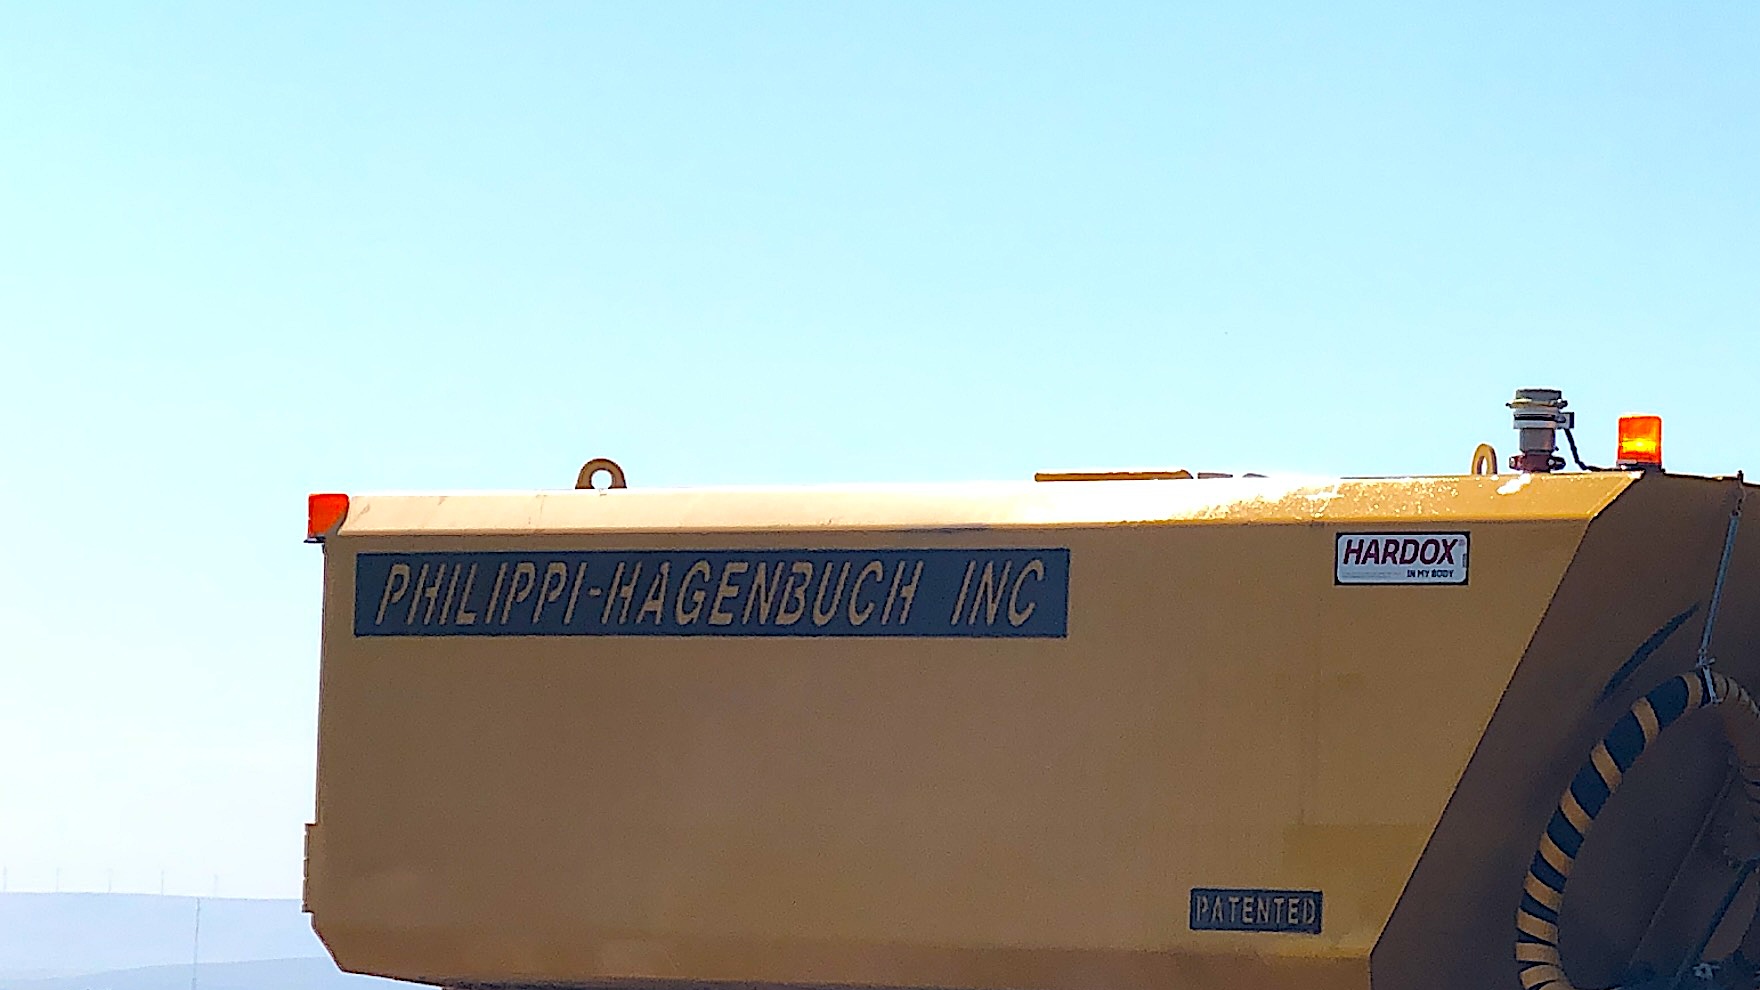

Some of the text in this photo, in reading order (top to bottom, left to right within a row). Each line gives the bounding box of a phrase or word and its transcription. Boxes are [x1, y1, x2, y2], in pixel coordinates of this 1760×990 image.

[1343, 538, 1458, 565] HARDOX
[1407, 570, 1416, 578] IN
[1417, 570, 1429, 578] MY
[1431, 569, 1454, 578] BODY
[374, 559, 1045, 627] PHILIPPI-HAGENBUCH INC
[1196, 894, 1316, 925] PATENTED
